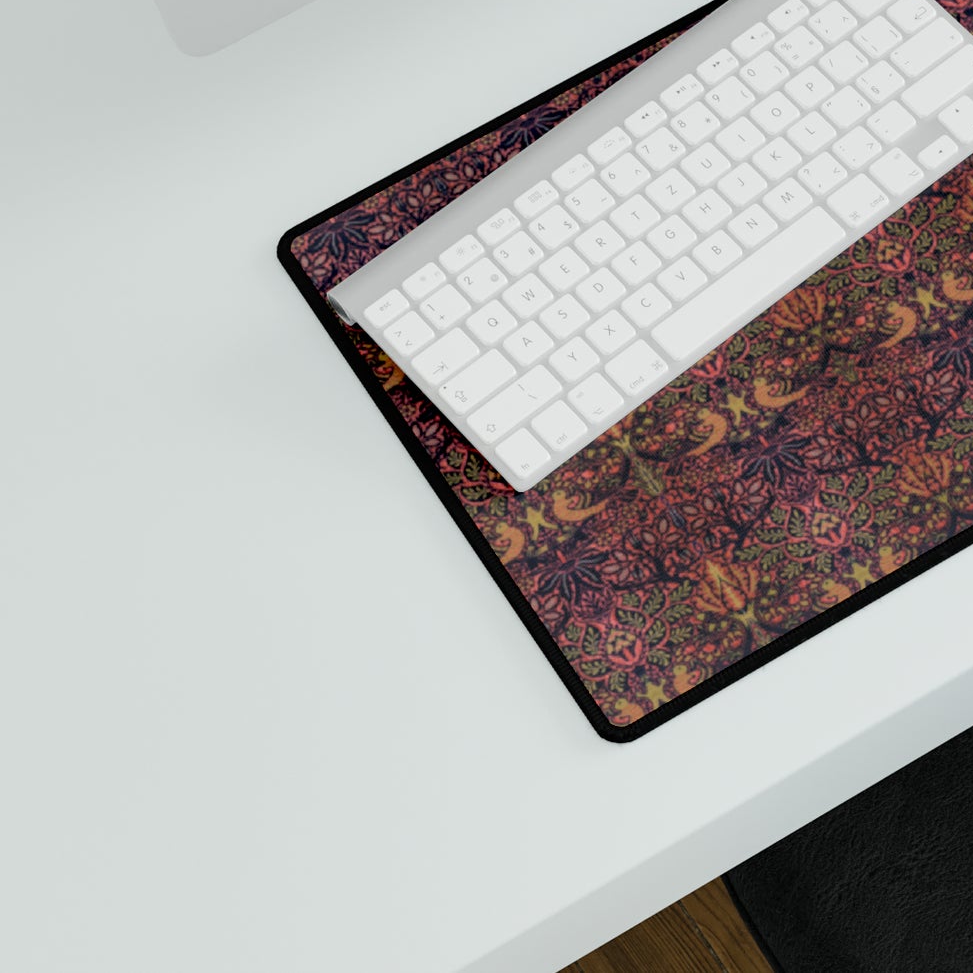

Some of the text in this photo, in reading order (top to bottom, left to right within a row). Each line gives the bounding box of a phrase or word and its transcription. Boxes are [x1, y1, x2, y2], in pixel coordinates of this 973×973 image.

[463, 275, 475, 286] 2
[499, 249, 510, 259] 3
[537, 222, 546, 232] 4
[571, 196, 582, 207] 5
[607, 171, 617, 180] 6
[640, 144, 650, 155] 7
[676, 119, 687, 129] 8
[711, 93, 721, 103] 9
[520, 288, 536, 302] W
[559, 263, 571, 275] E
[594, 237, 607, 248] R
[630, 210, 641, 221] T
[665, 184, 678, 196] Z
[700, 157, 713, 170] U
[804, 82, 814, 92] P
[521, 126, 817, 348] A S D F G H J K L
[566, 191, 795, 362] Y X C V B N M
